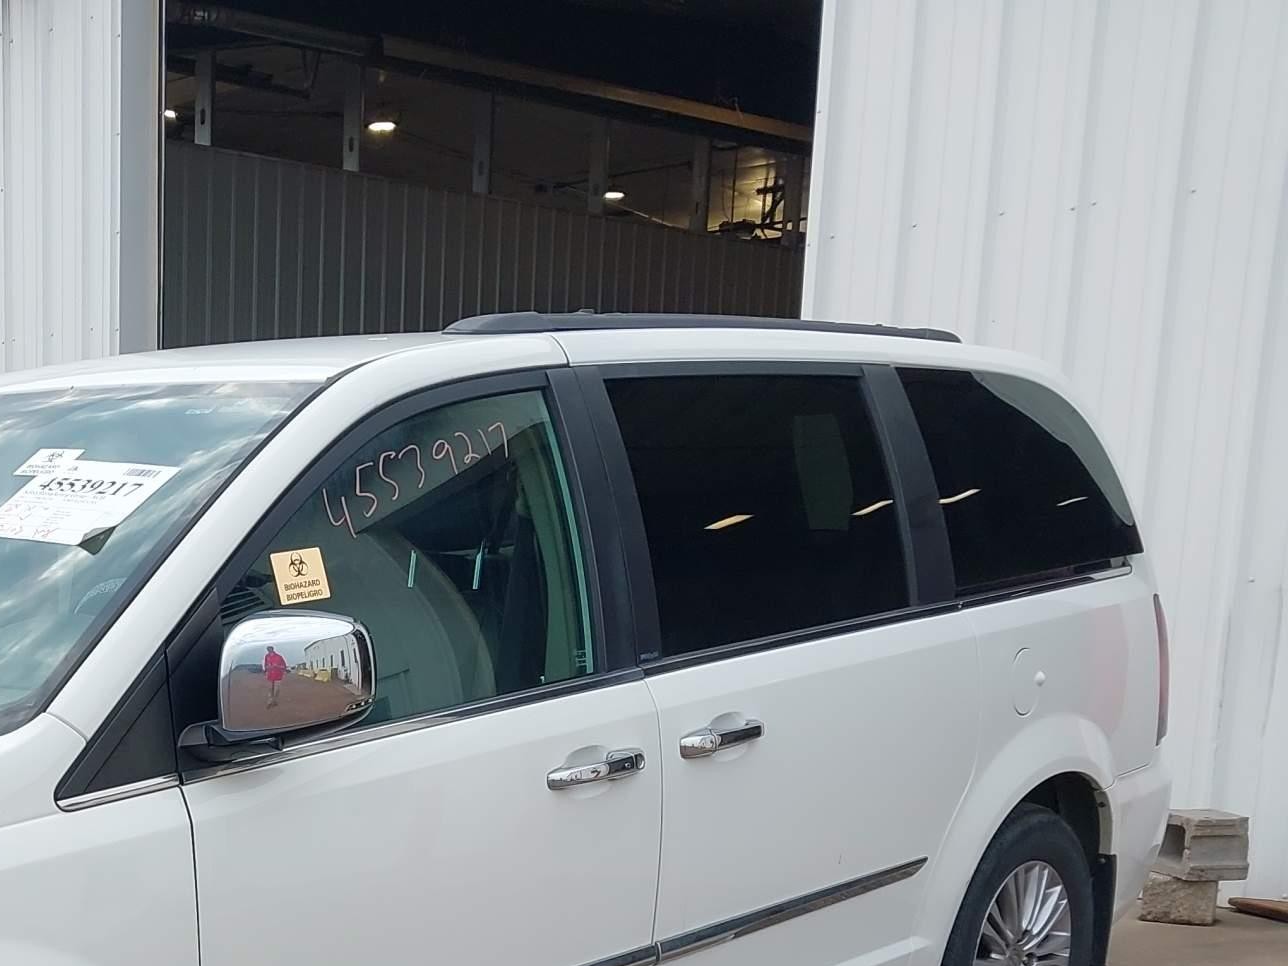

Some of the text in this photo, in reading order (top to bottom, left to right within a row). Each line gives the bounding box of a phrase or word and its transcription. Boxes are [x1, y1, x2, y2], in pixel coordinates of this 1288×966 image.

[40, 477, 144, 497] 45539217
[323, 422, 509, 538] 45539217
[284, 579, 320, 591] BIOHAZARD
[286, 589, 323, 601] BIOPELIGRO
